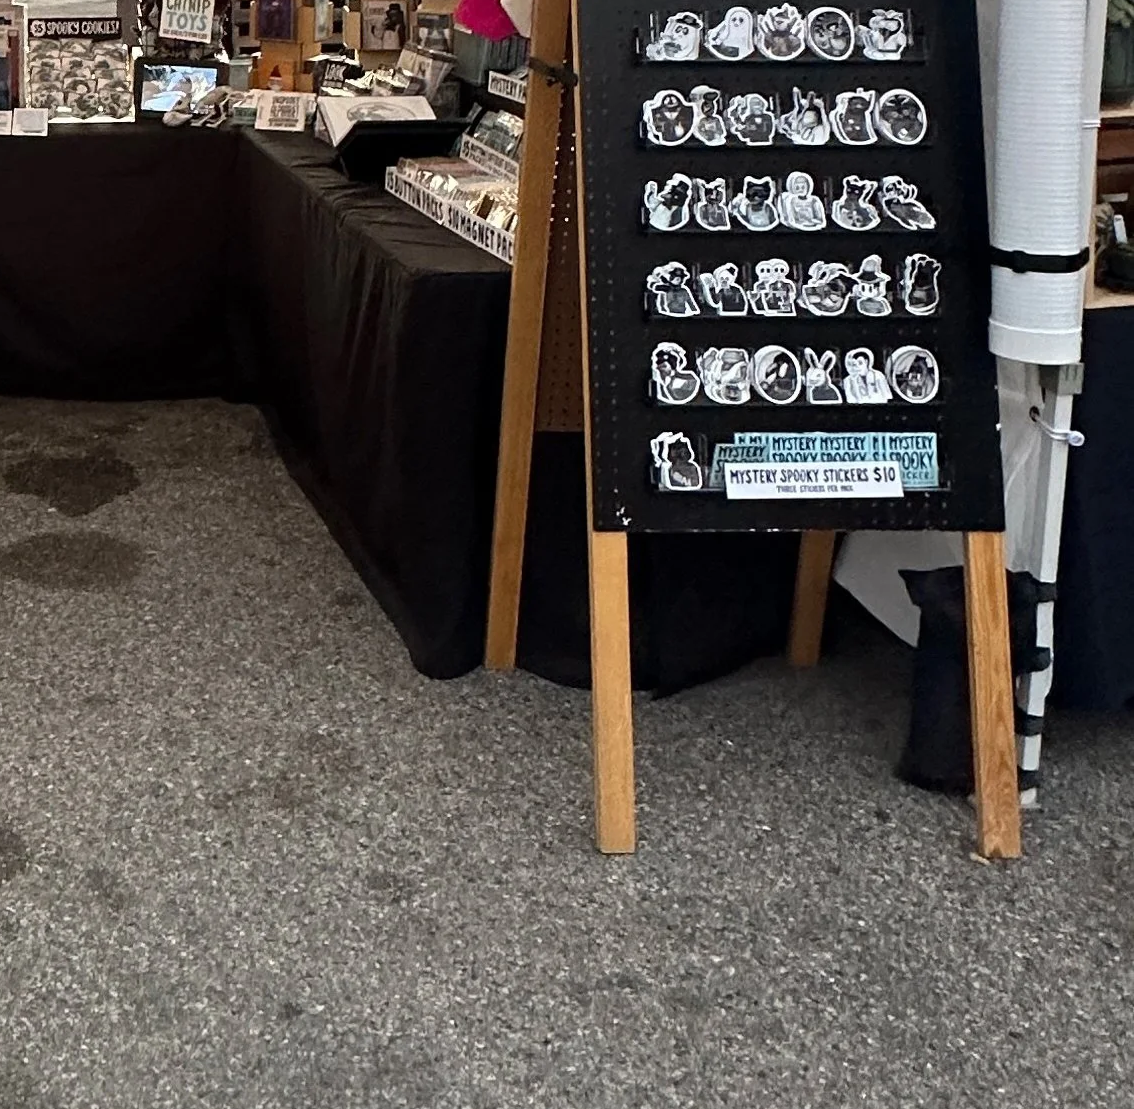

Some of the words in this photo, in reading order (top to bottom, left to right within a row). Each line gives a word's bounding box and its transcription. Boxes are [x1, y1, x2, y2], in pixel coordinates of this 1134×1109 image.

[46, 21, 80, 36] SPOOKY
[81, 20, 120, 35] COOKIES!
[166, 11, 208, 32] TOYS
[459, 213, 495, 252] MAGNET
[772, 436, 817, 451] MYSTERY
[820, 436, 866, 450] MYSTERY
[889, 435, 934, 450] MYSTERY
[718, 446, 767, 458] MYSTERY
[729, 469, 778, 485] MYSTERY
[779, 468, 820, 483] SPOOKY
[823, 467, 869, 483] STICKERS
[873, 466, 896, 483] $10
